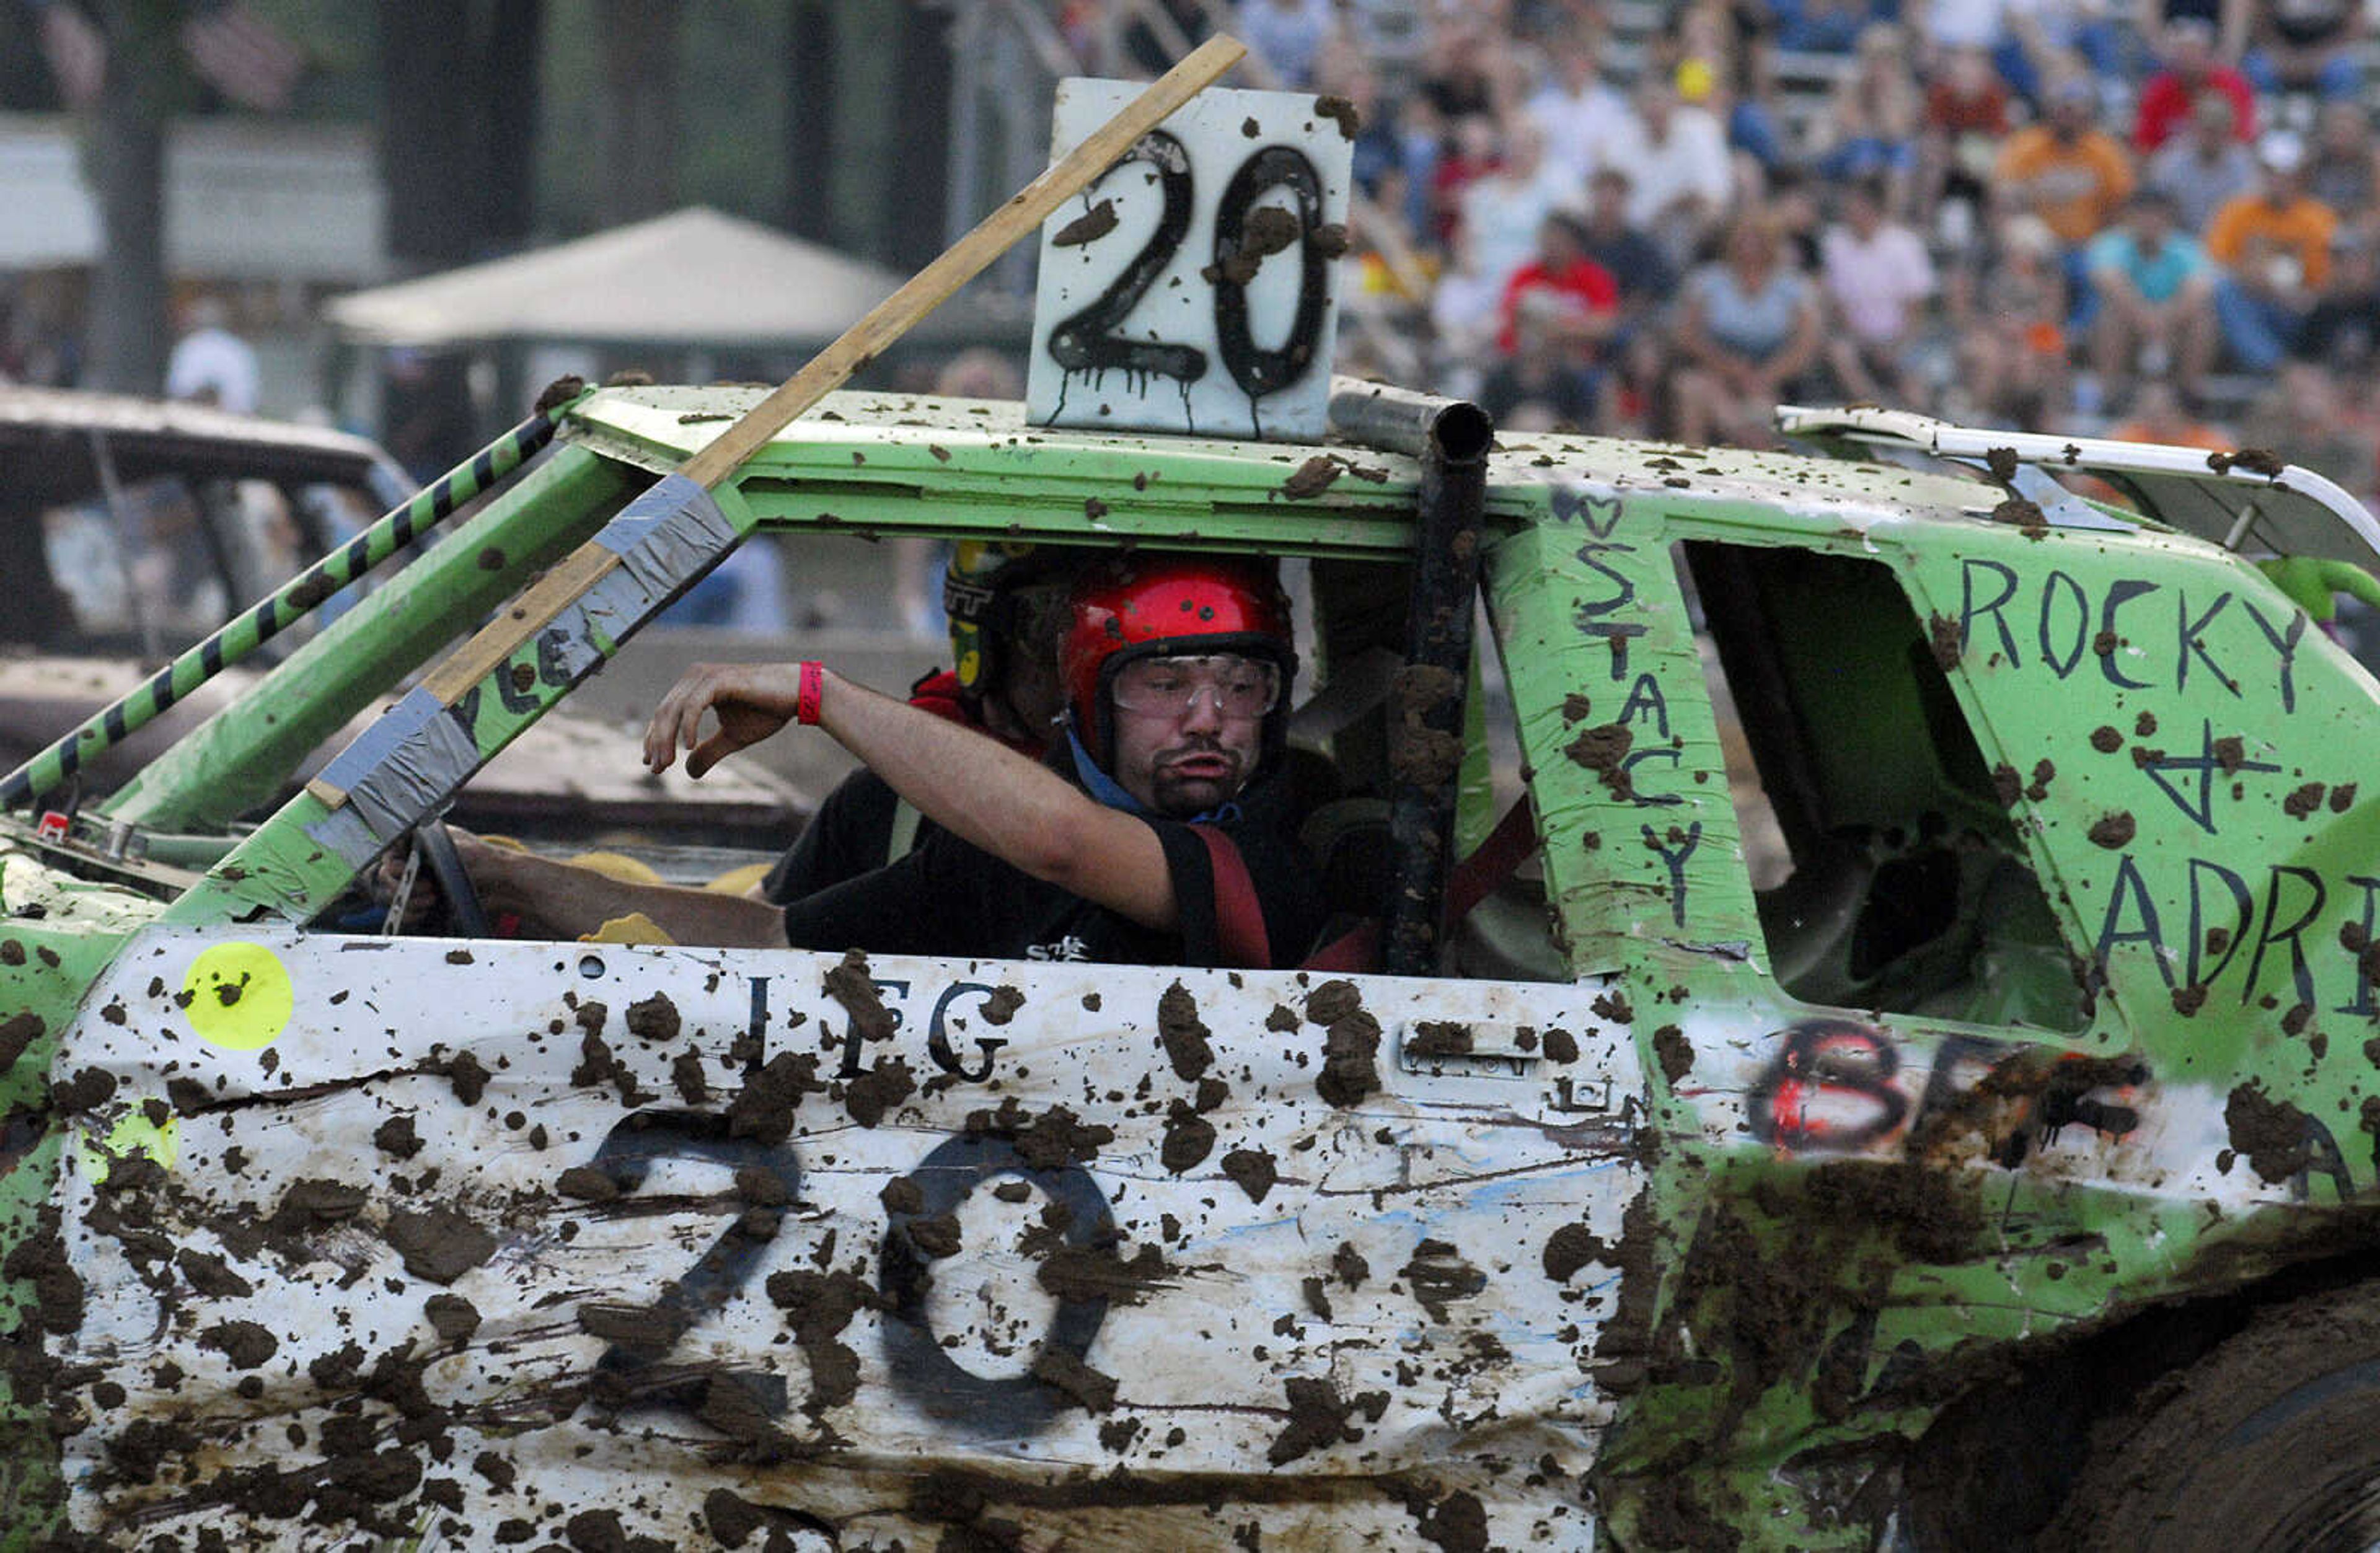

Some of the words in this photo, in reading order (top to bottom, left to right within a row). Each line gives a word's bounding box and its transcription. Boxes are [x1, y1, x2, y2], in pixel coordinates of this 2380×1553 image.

[1047, 128, 1328, 400] 20
[1575, 542, 1702, 928] STACY
[1960, 559, 2307, 714] ROCKY
[583, 1111, 1117, 1439] 20
